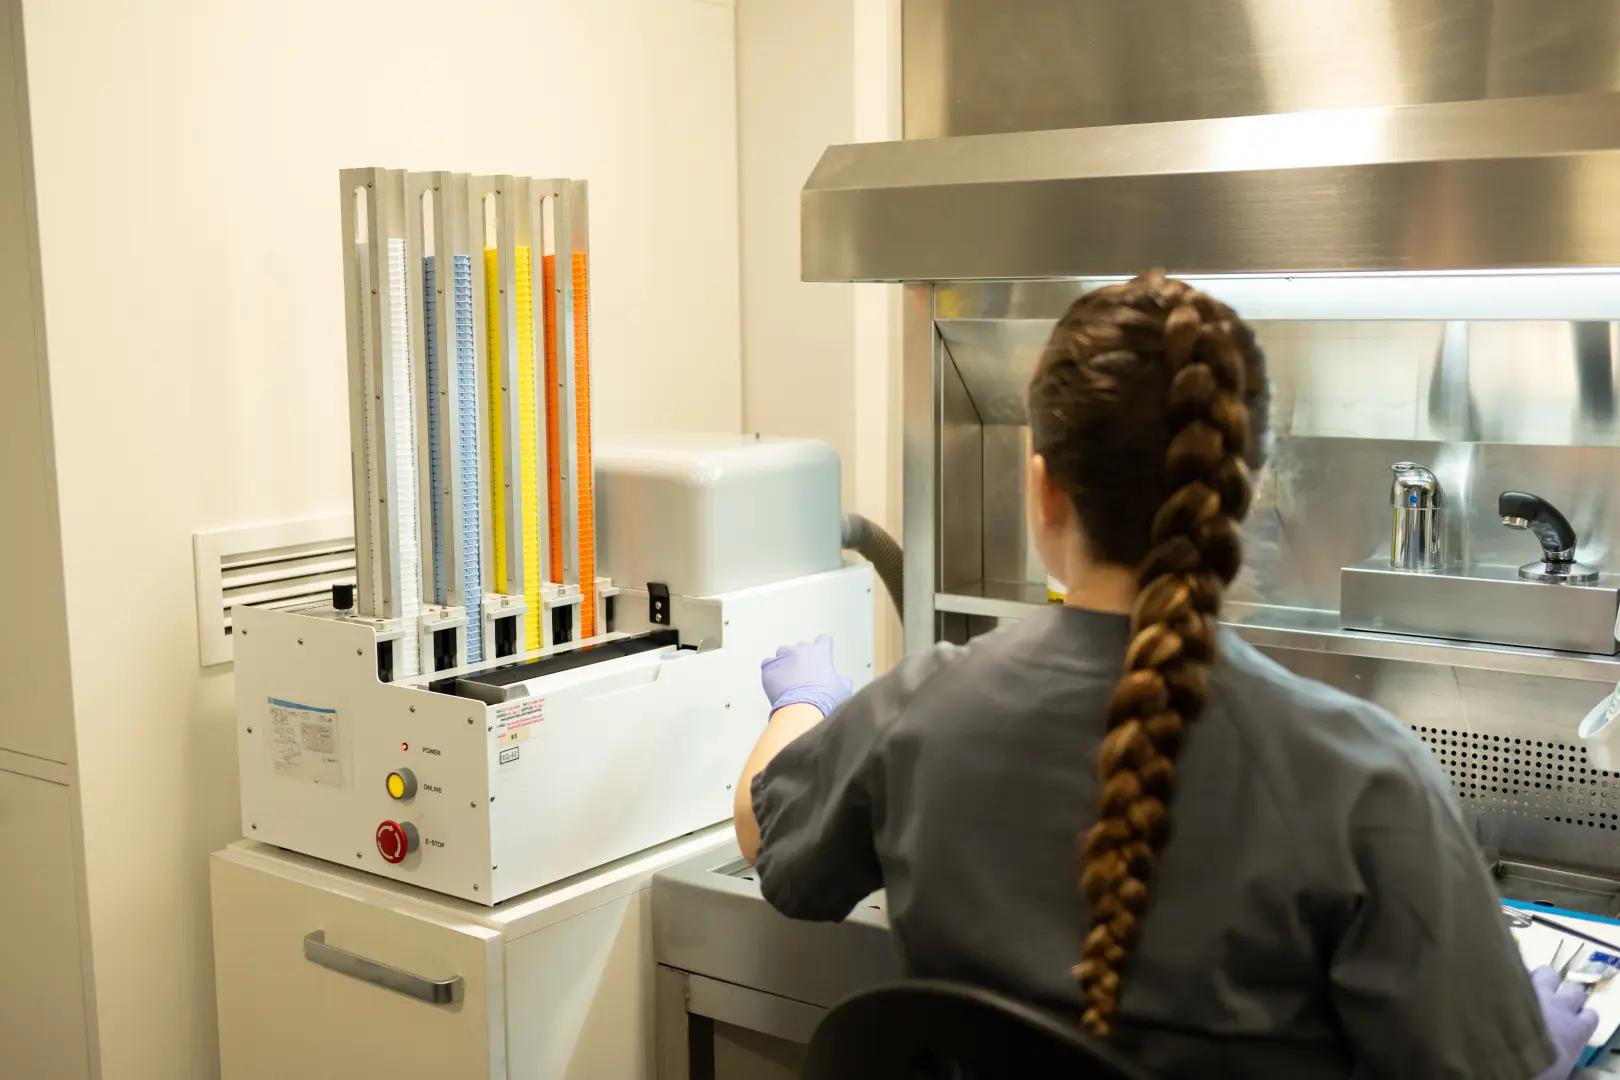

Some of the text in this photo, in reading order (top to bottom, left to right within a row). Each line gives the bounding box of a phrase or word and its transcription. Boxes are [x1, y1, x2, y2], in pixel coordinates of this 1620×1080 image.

[422, 746, 441, 756] POWER
[423, 783, 442, 793] ONLINE
[425, 838, 445, 848] E-STOP
